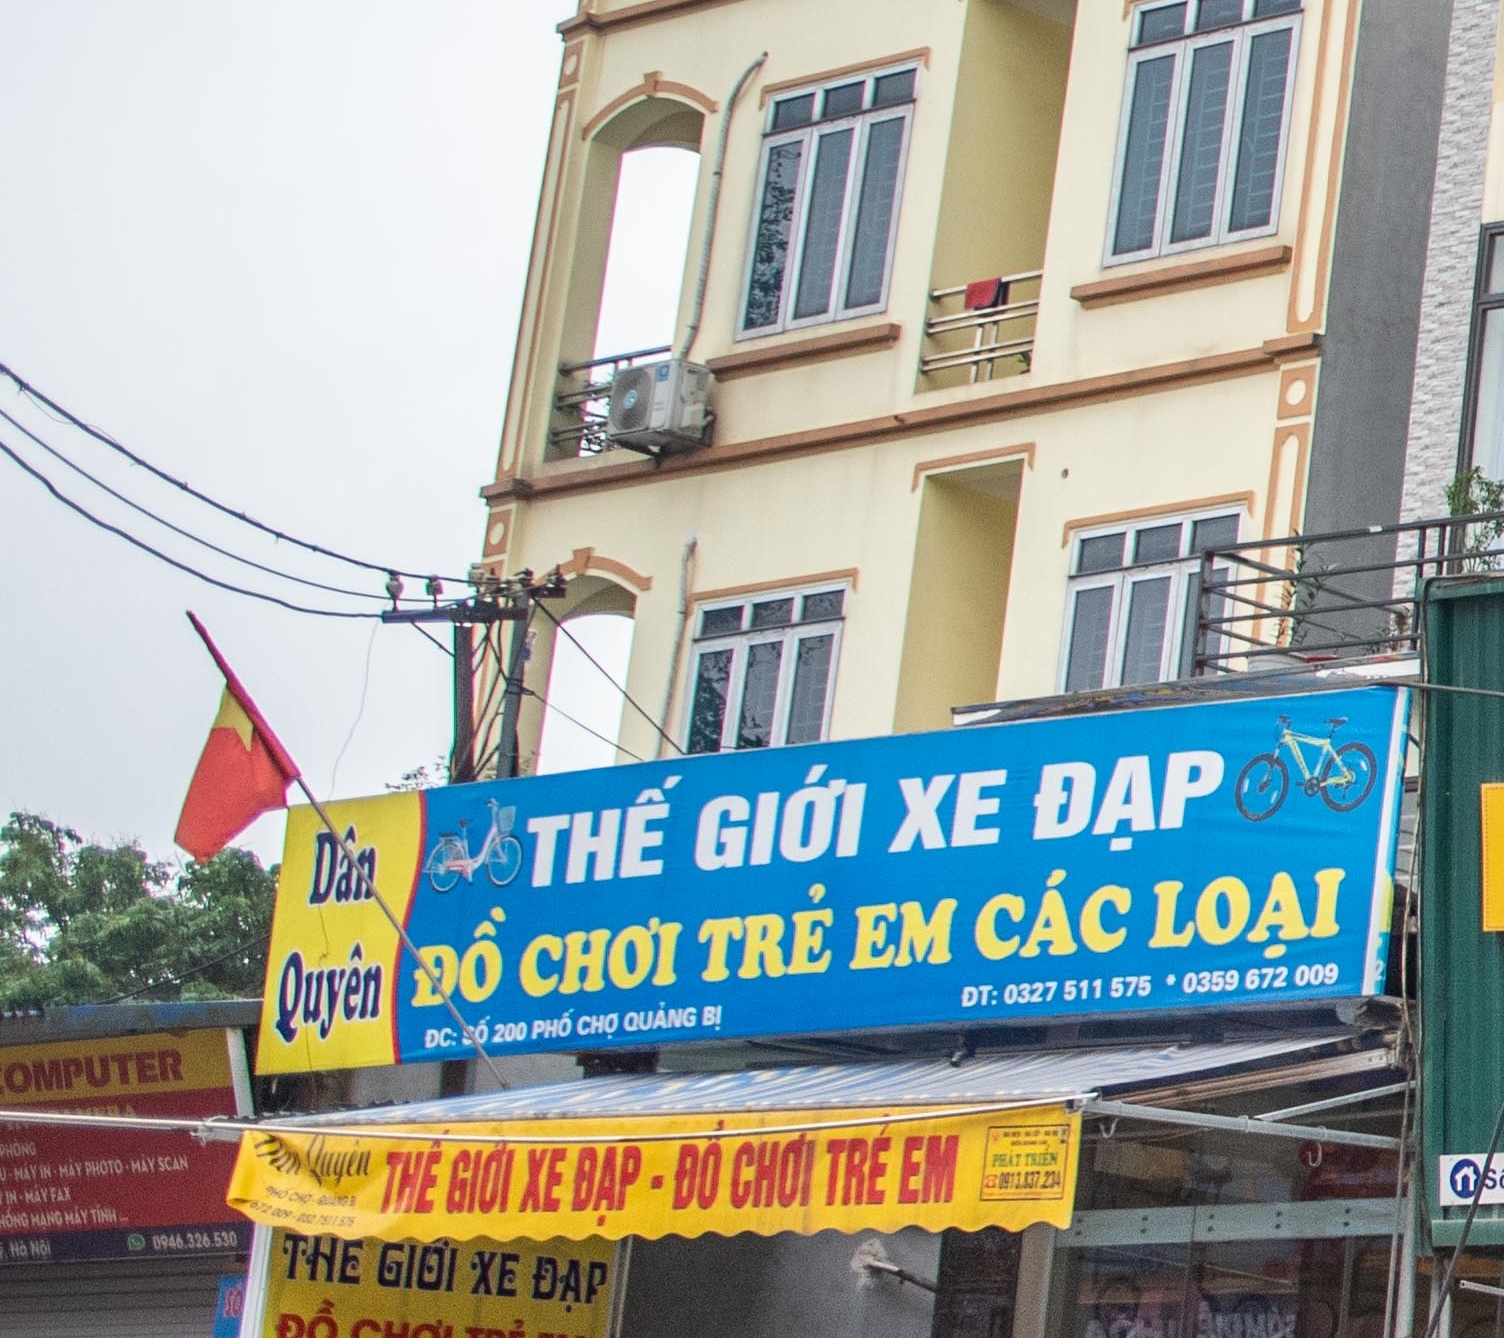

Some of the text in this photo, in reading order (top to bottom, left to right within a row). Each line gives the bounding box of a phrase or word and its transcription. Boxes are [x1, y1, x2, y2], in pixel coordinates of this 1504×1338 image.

[527, 750, 1225, 888] THẾ GIỚI XE ĐẠP
[309, 825, 379, 906] Dân
[412, 868, 1346, 1008] ĐỒ CHƠI TRẺ EM CÁC LOẠI
[275, 942, 384, 1042] Quyên
[425, 1028, 458, 1049] ĐC:
[494, 1021, 527, 1043] 200
[531, 1008, 574, 1040] PHỐ
[577, 1012, 619, 1042] CHỢ
[623, 1001, 698, 1033] QUẢNG
[702, 1005, 722, 1033] BỊ
[962, 963, 1340, 1008] ĐT: 0327 511 575 0359 672 009
[381, 1114, 961, 1227] THẾ GIỚI XE ĐẠP ĐỒ CHƠI TRẺ EM
[471, 1250, 609, 1313] XE ĐẠP
